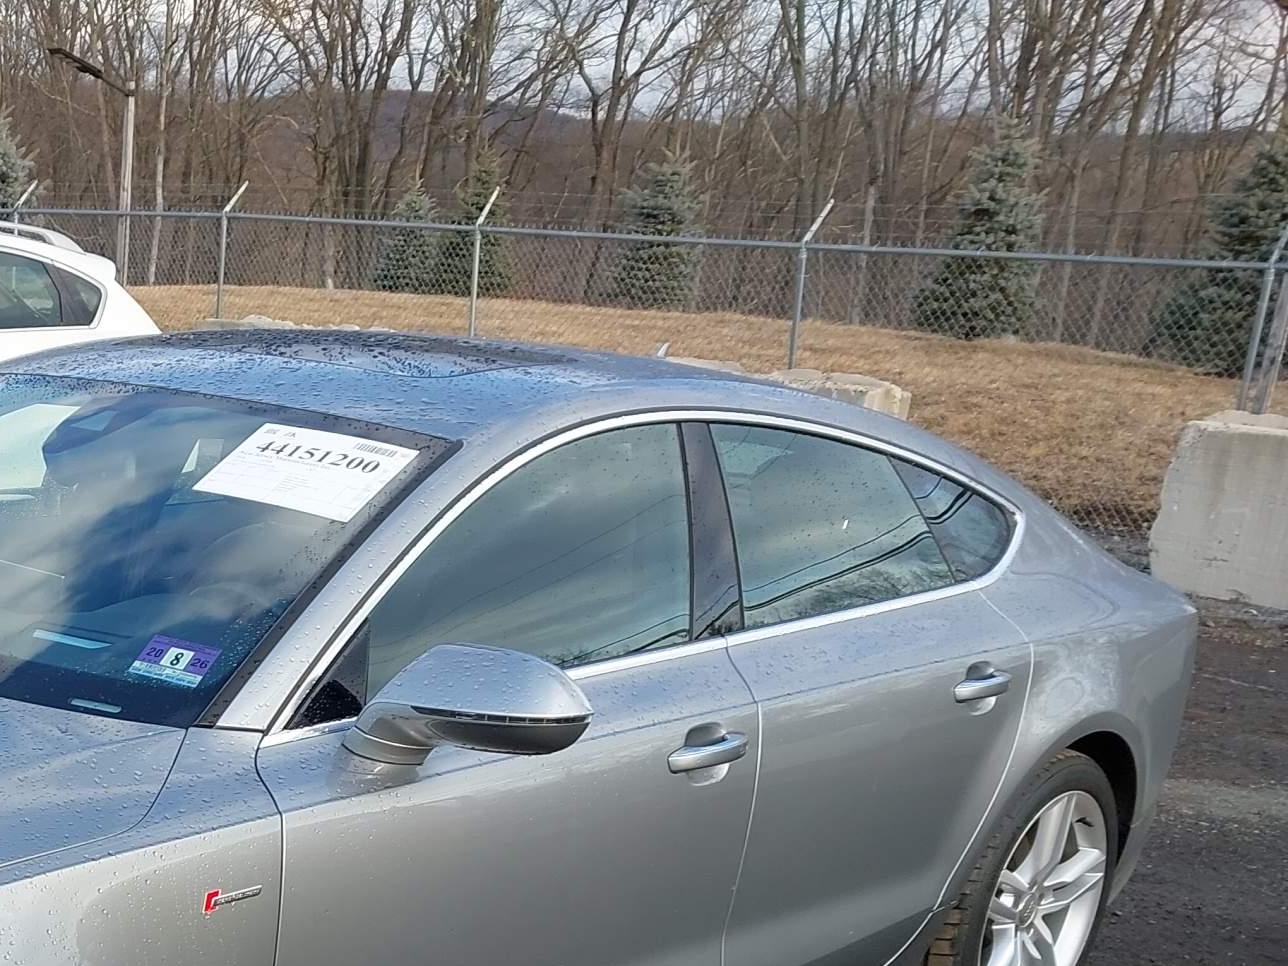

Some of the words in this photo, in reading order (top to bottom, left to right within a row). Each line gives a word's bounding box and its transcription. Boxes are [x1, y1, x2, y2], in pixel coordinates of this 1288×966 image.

[256, 440, 381, 474] 44151200
[146, 646, 165, 659] 20
[171, 652, 185, 666] 8
[190, 658, 210, 669] 26
